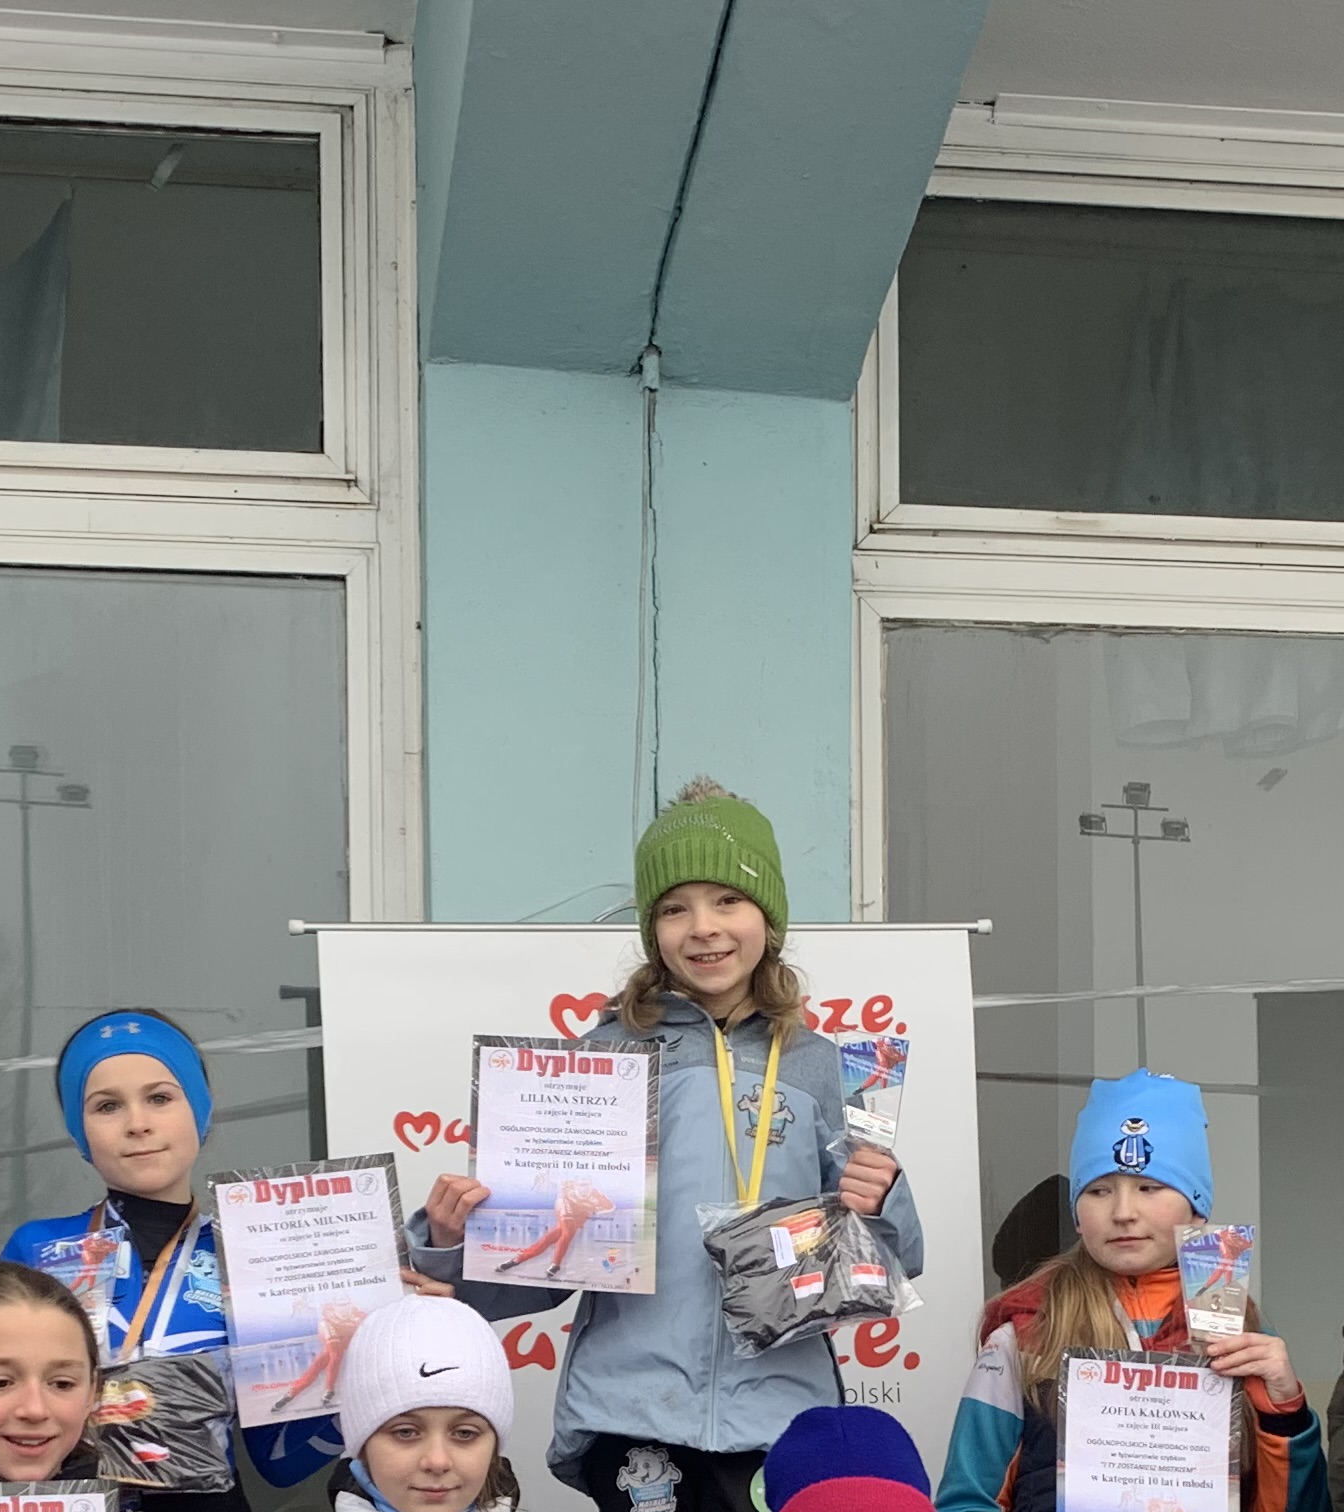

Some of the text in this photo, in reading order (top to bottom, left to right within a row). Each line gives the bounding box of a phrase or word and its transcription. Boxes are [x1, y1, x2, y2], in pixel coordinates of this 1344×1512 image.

[517, 1048, 613, 1077] Dyplom
[515, 1160, 559, 1170] kategorii
[254, 1176, 352, 1203] Dyplom
[1104, 1361, 1199, 1391] Dyplom
[843, 1381, 902, 1405] olski
